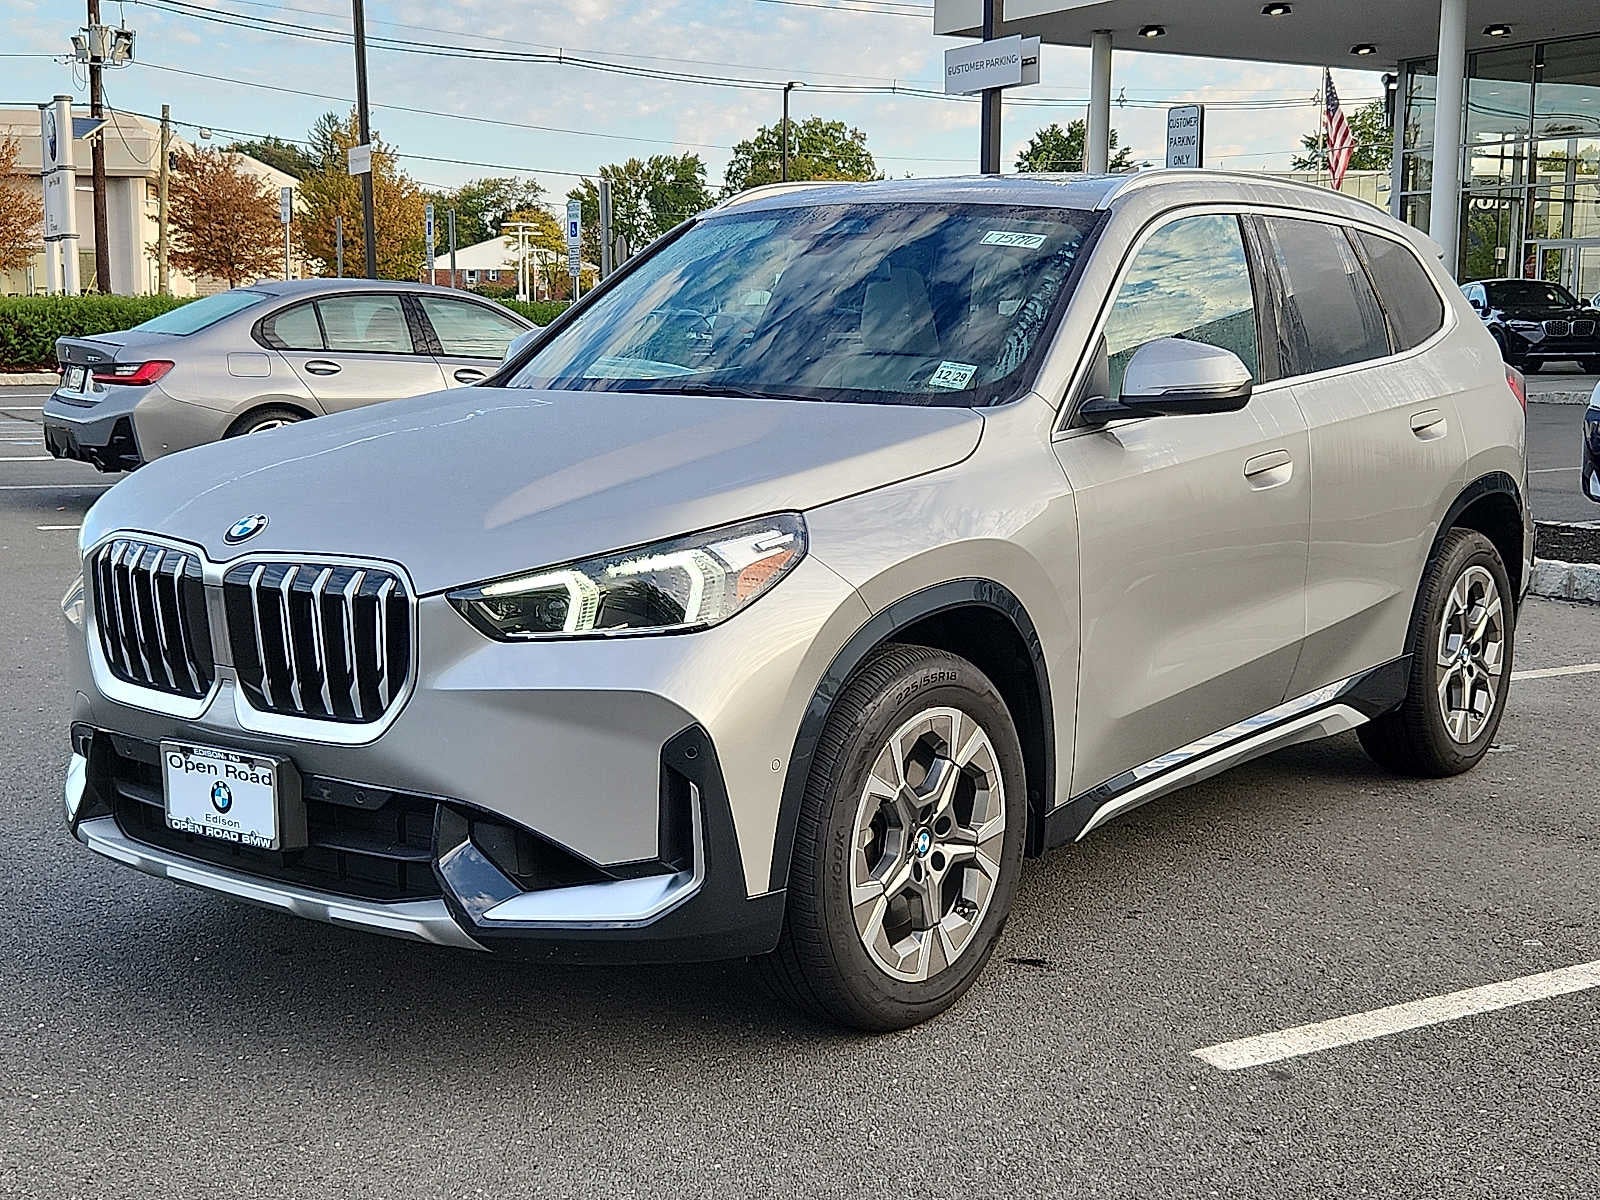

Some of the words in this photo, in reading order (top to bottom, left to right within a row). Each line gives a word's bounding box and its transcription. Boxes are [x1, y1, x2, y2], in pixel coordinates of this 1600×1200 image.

[947, 60, 985, 76] CUSTOMER
[985, 54, 1019, 69] PARKING
[1169, 116, 1198, 129] CUSTOMER
[1169, 135, 1196, 147] PARKING
[1173, 154, 1190, 166] ONLY
[936, 369, 952, 380] 12
[952, 371, 968, 382] 29
[895, 671, 957, 706] 225/55R18
[228, 754, 241, 763] NJ
[168, 754, 218, 775] Open
[225, 763, 273, 787] Road
[205, 812, 241, 829] Edison
[171, 819, 203, 834] OPEN
[205, 825, 239, 842] ROAD
[242, 834, 272, 848] BMW
